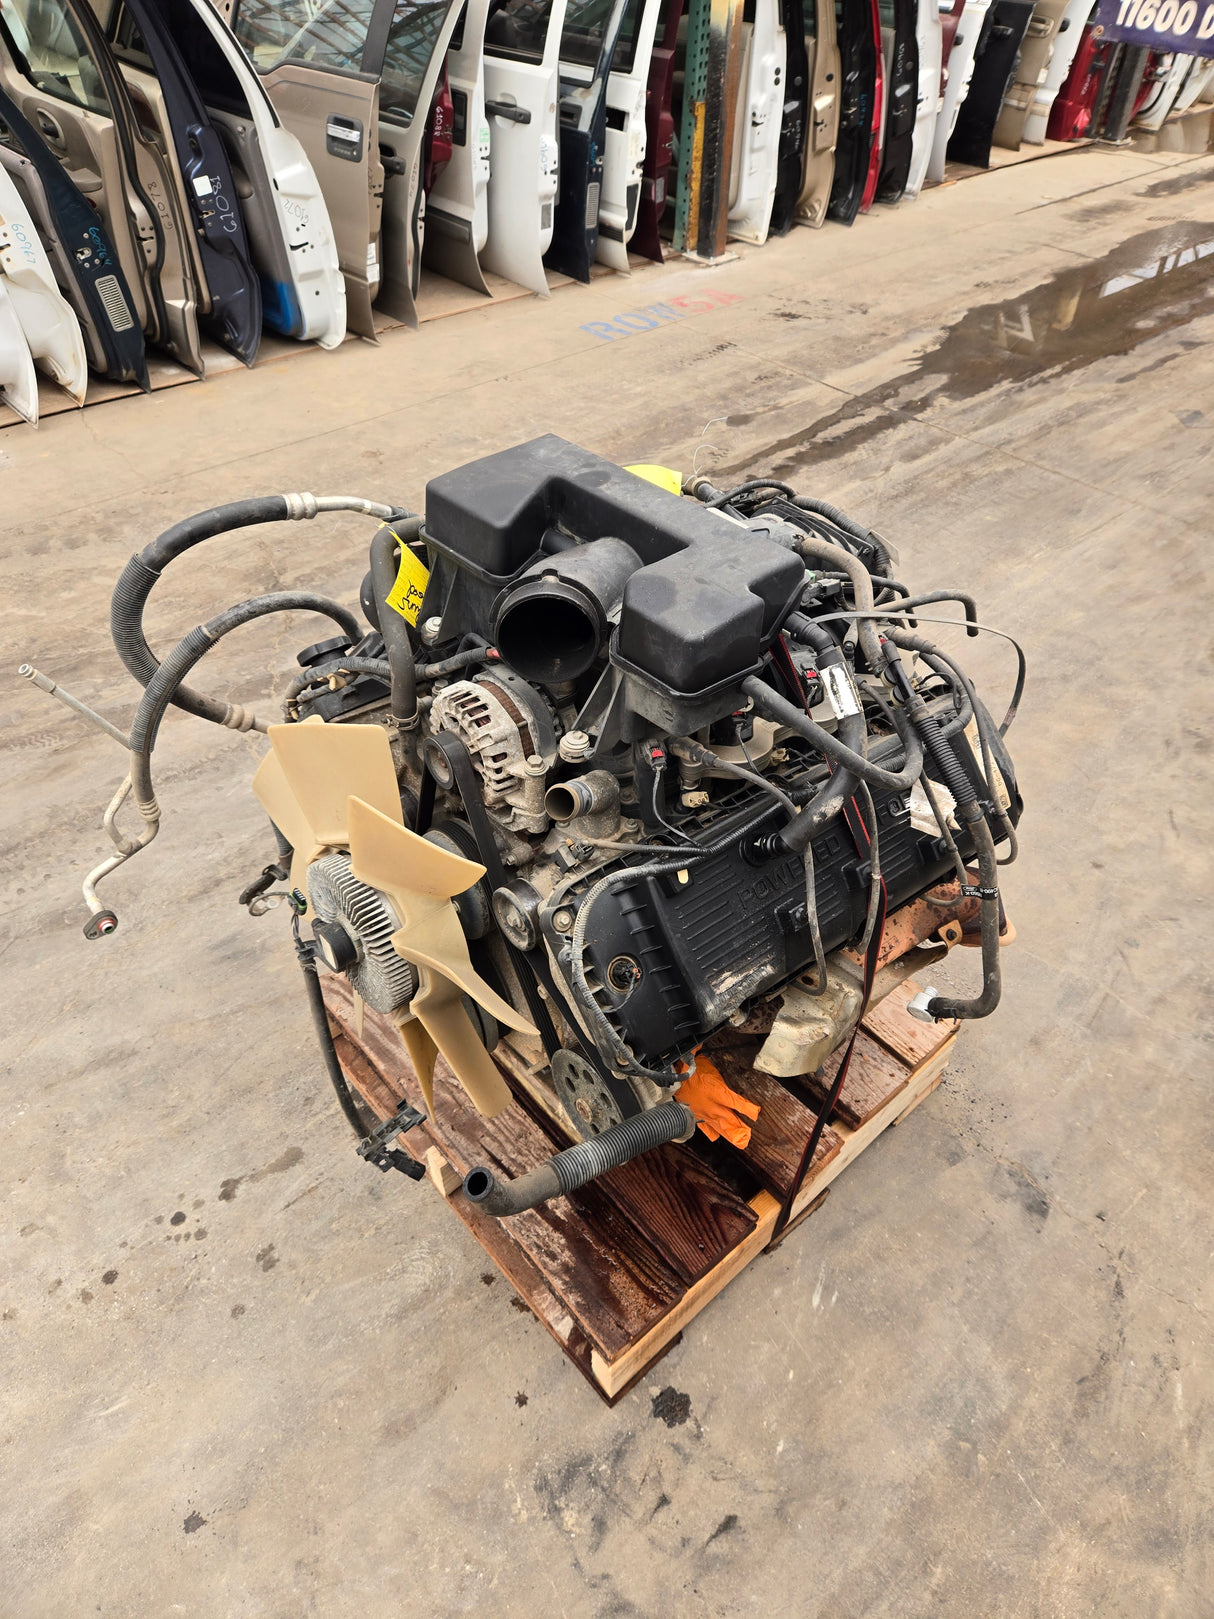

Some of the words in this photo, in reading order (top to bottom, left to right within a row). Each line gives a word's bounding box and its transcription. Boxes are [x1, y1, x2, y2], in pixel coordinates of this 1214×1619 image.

[1115, 0, 1198, 36] 11600
[209, 175, 238, 233] 61081
[736, 834, 841, 910] POWEED
